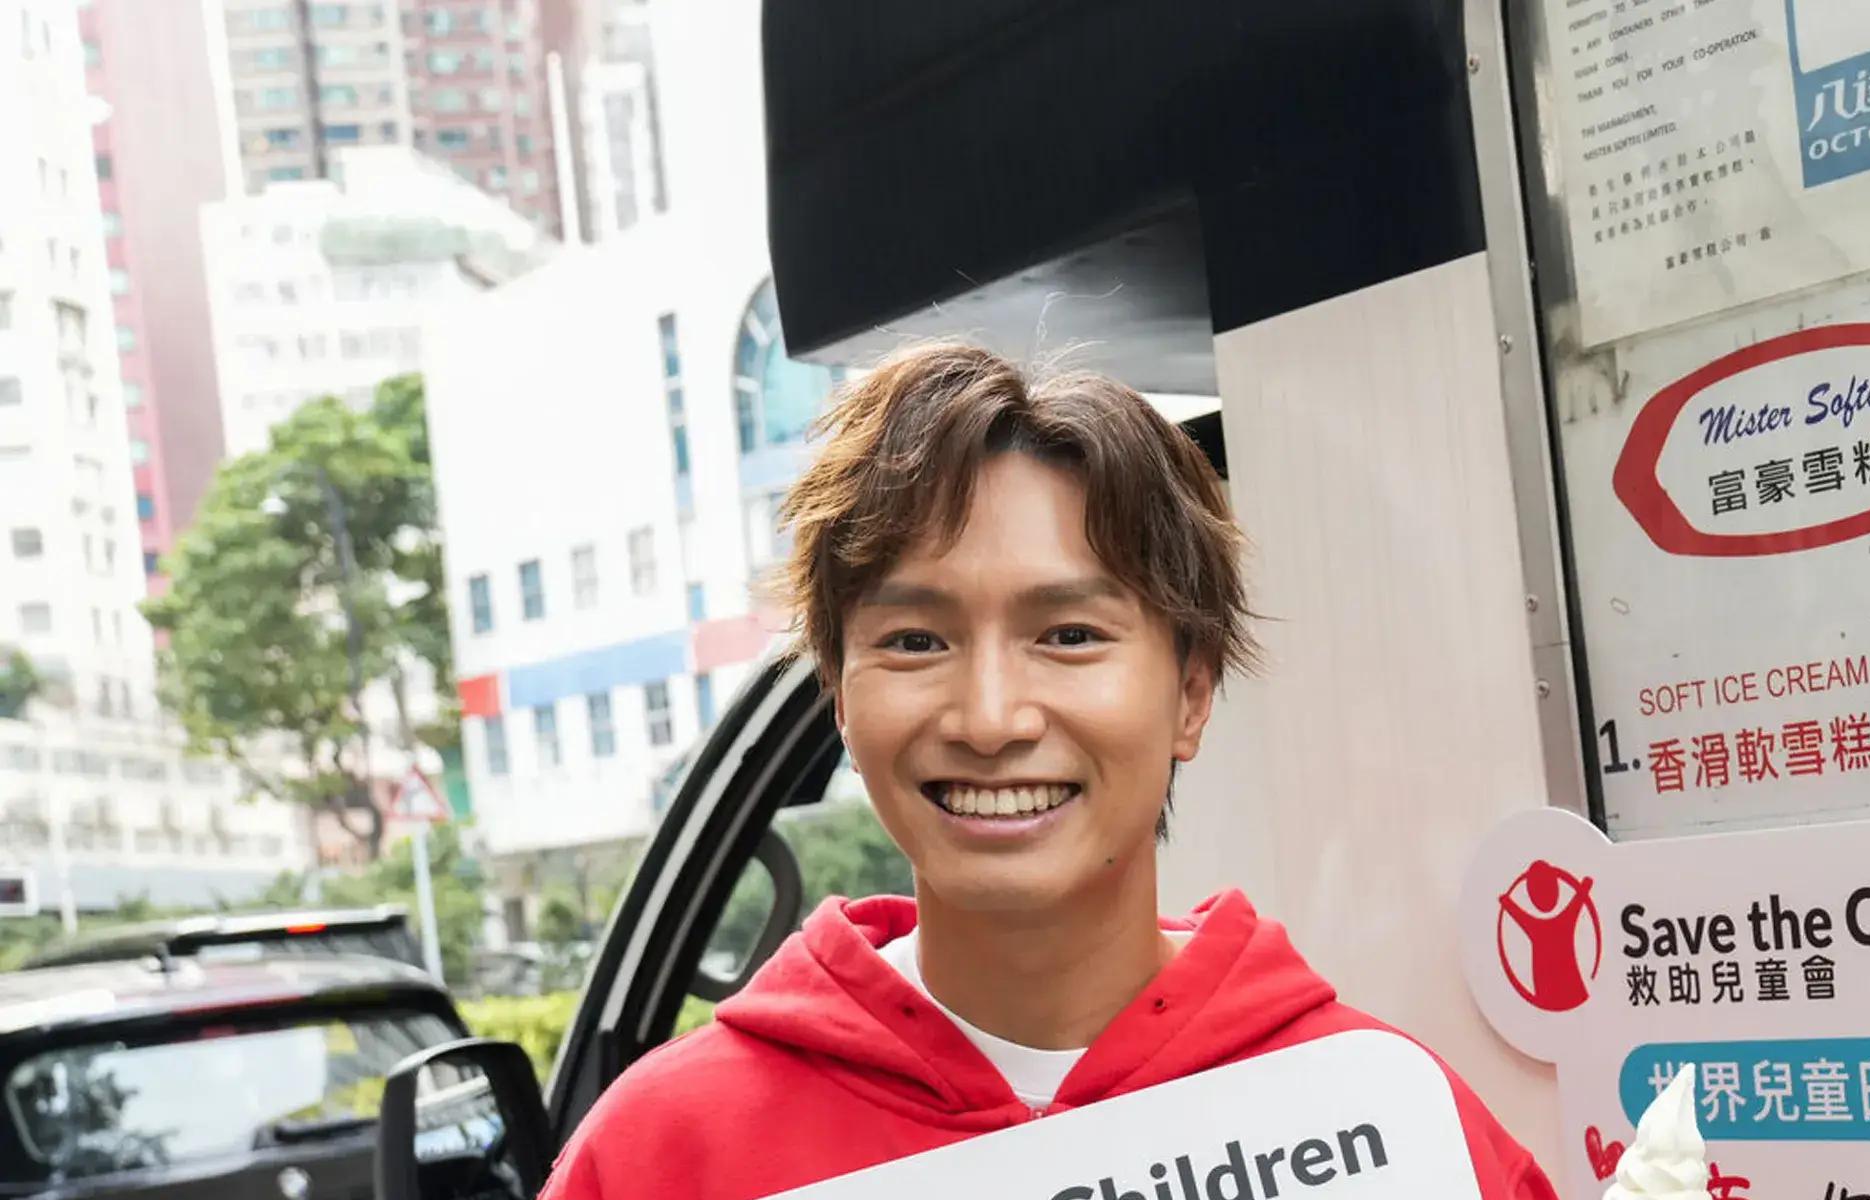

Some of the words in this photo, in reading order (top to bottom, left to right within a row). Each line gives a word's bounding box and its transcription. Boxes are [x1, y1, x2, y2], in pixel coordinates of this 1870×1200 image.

[1608, 17, 1654, 42] CONTAINERS
[1637, 67, 1654, 83] FOR
[1661, 55, 1685, 73] YOUR
[1698, 401, 1793, 445] Mister
[1639, 679, 1706, 717] SOFT
[1714, 672, 1758, 706] ICE
[1766, 655, 1870, 698] CREAM
[1598, 718, 1641, 774] 1.
[1621, 902, 1736, 959] Save
[1747, 894, 1834, 952] the
[1626, 954, 1836, 1007] 救助兒童會
